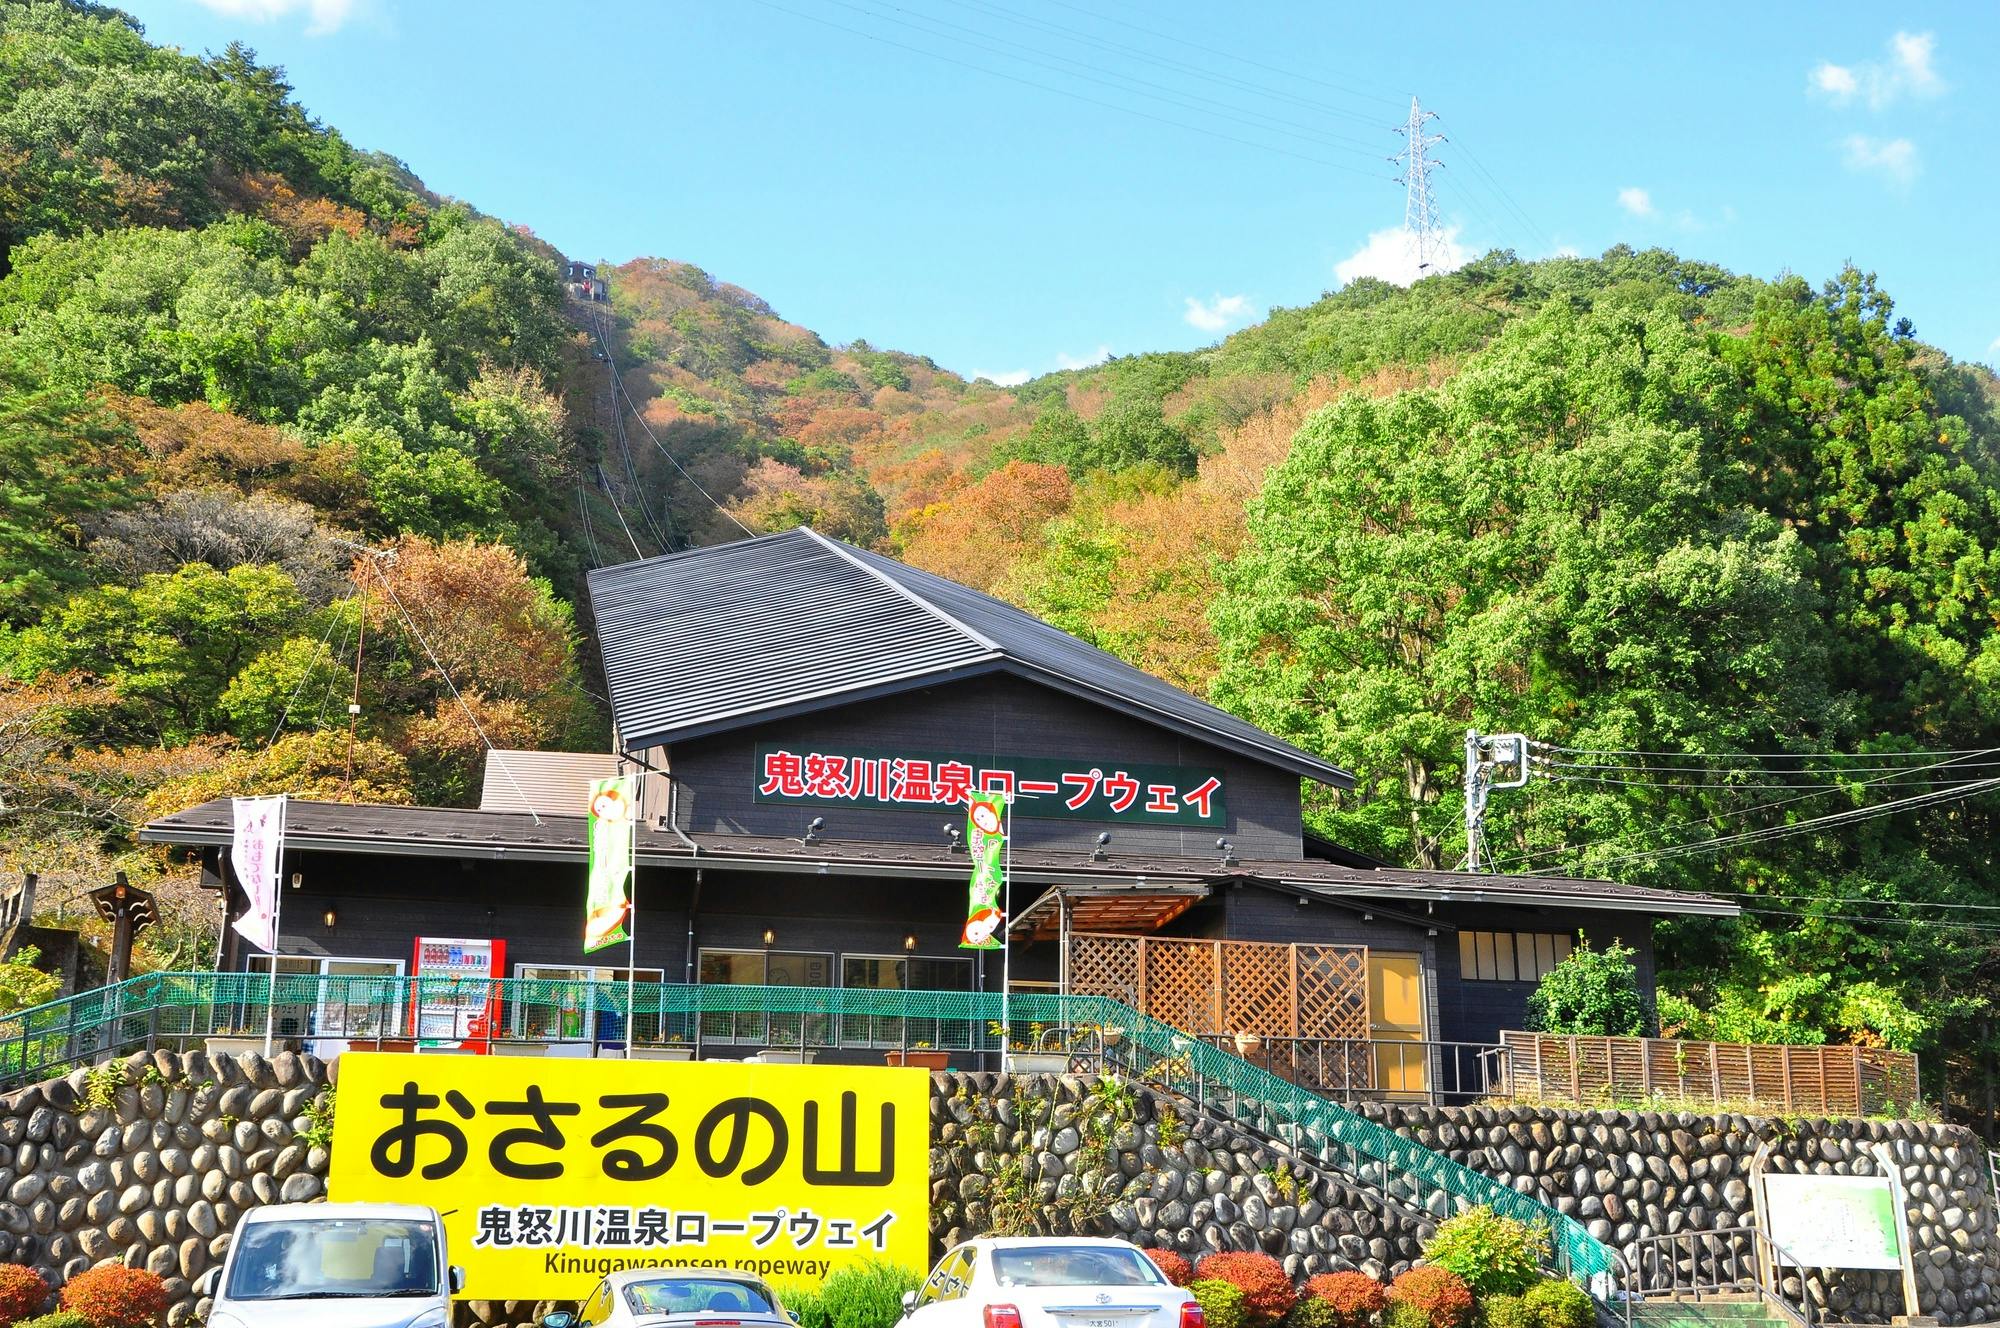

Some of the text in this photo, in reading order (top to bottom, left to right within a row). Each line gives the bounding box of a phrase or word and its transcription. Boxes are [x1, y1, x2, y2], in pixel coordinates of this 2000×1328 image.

[760, 750, 1223, 818] 鬼怒川温泉ロープウェイ
[370, 1081, 896, 1187] おさるの山
[475, 1206, 896, 1250] 鬼怒川温泉ロープウェイ
[735, 1258, 831, 1281] ropeway
